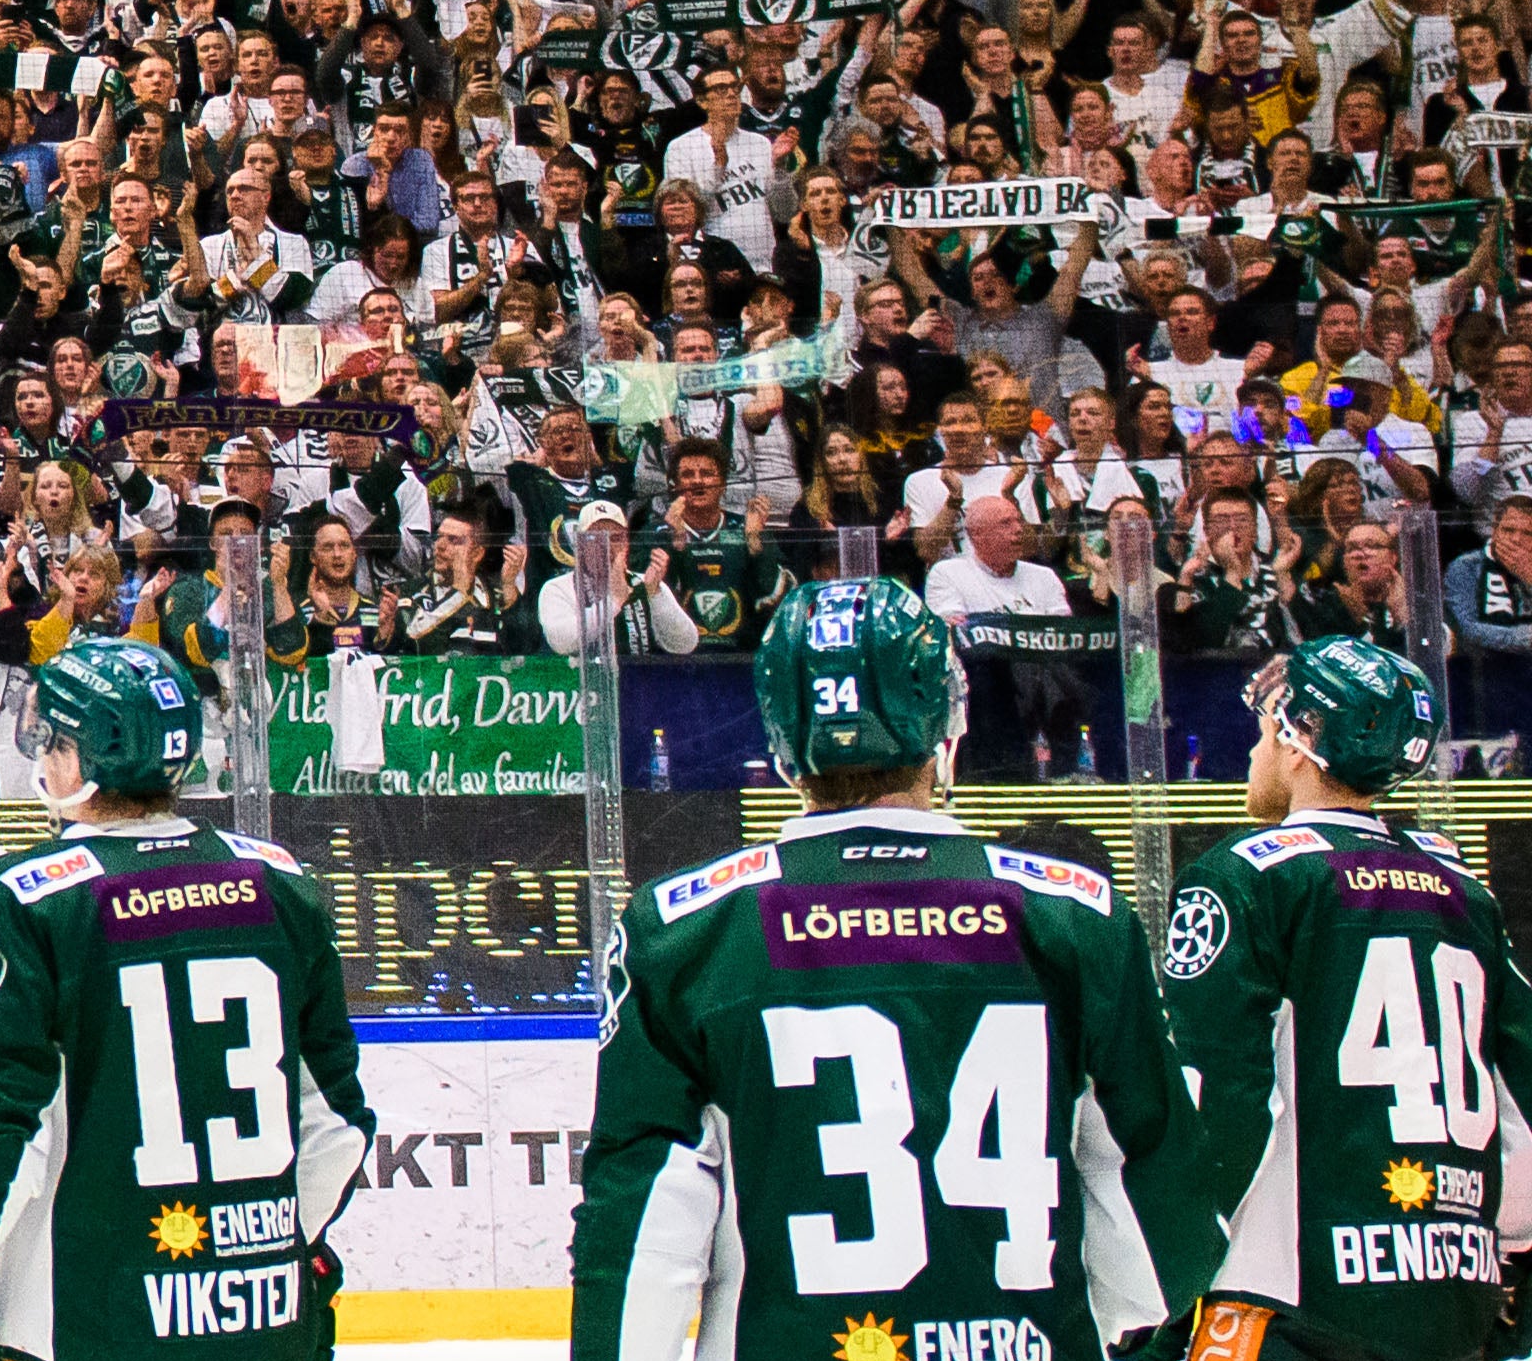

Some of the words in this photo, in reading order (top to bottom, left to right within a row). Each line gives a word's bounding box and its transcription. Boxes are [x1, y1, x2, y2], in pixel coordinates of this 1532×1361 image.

[718, 186, 766, 213] FBK
[973, 624, 1012, 649] DEN
[1018, 626, 1084, 652] SKÖLD
[1087, 630, 1117, 651] DU
[814, 679, 860, 715] 34
[163, 730, 187, 760] 13
[1403, 737, 1428, 763] 40
[460, 769, 488, 795] av
[842, 844, 928, 861] CCM
[14, 854, 92, 900] ELON
[667, 850, 773, 907] ELON
[997, 850, 1100, 899] ELON
[1345, 866, 1451, 899] LÖFBERG
[112, 877, 259, 924] LÖFBERGS
[782, 902, 1008, 945] LÖFBERGS
[1338, 936, 1489, 1152] 40
[118, 955, 297, 1190] 13
[761, 1003, 1064, 1297] 34
[210, 1193, 297, 1245] ENERGI
